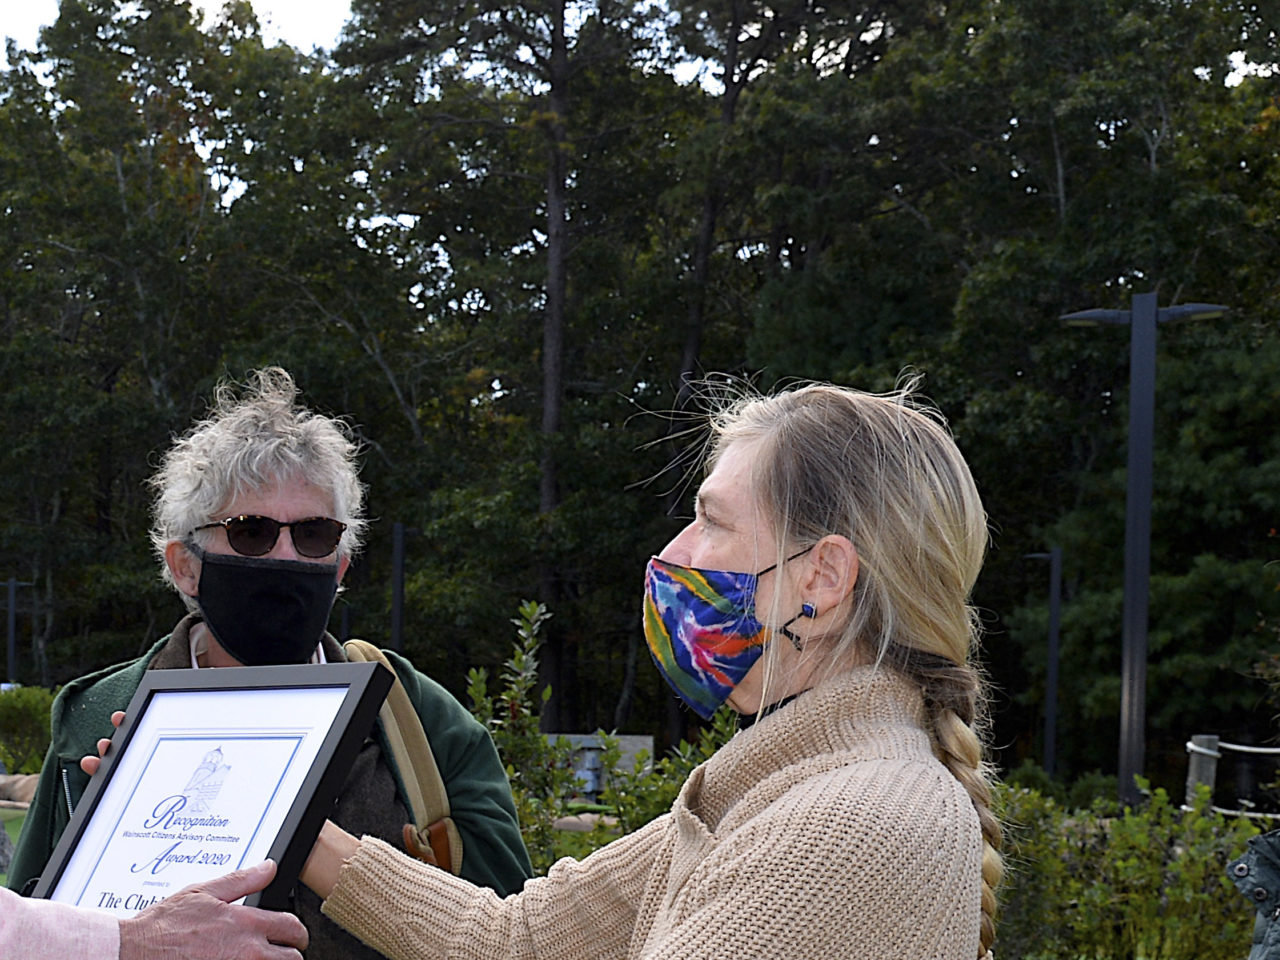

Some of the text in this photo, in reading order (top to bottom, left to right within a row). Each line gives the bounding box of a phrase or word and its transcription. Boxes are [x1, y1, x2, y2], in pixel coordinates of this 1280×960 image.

[143, 795, 229, 831] Recognition
[151, 831, 175, 839] Citizens
[177, 833, 203, 842] Advisory
[205, 834, 240, 843] Committee
[130, 841, 231, 875] Award 2020
[97, 891, 122, 909] The
